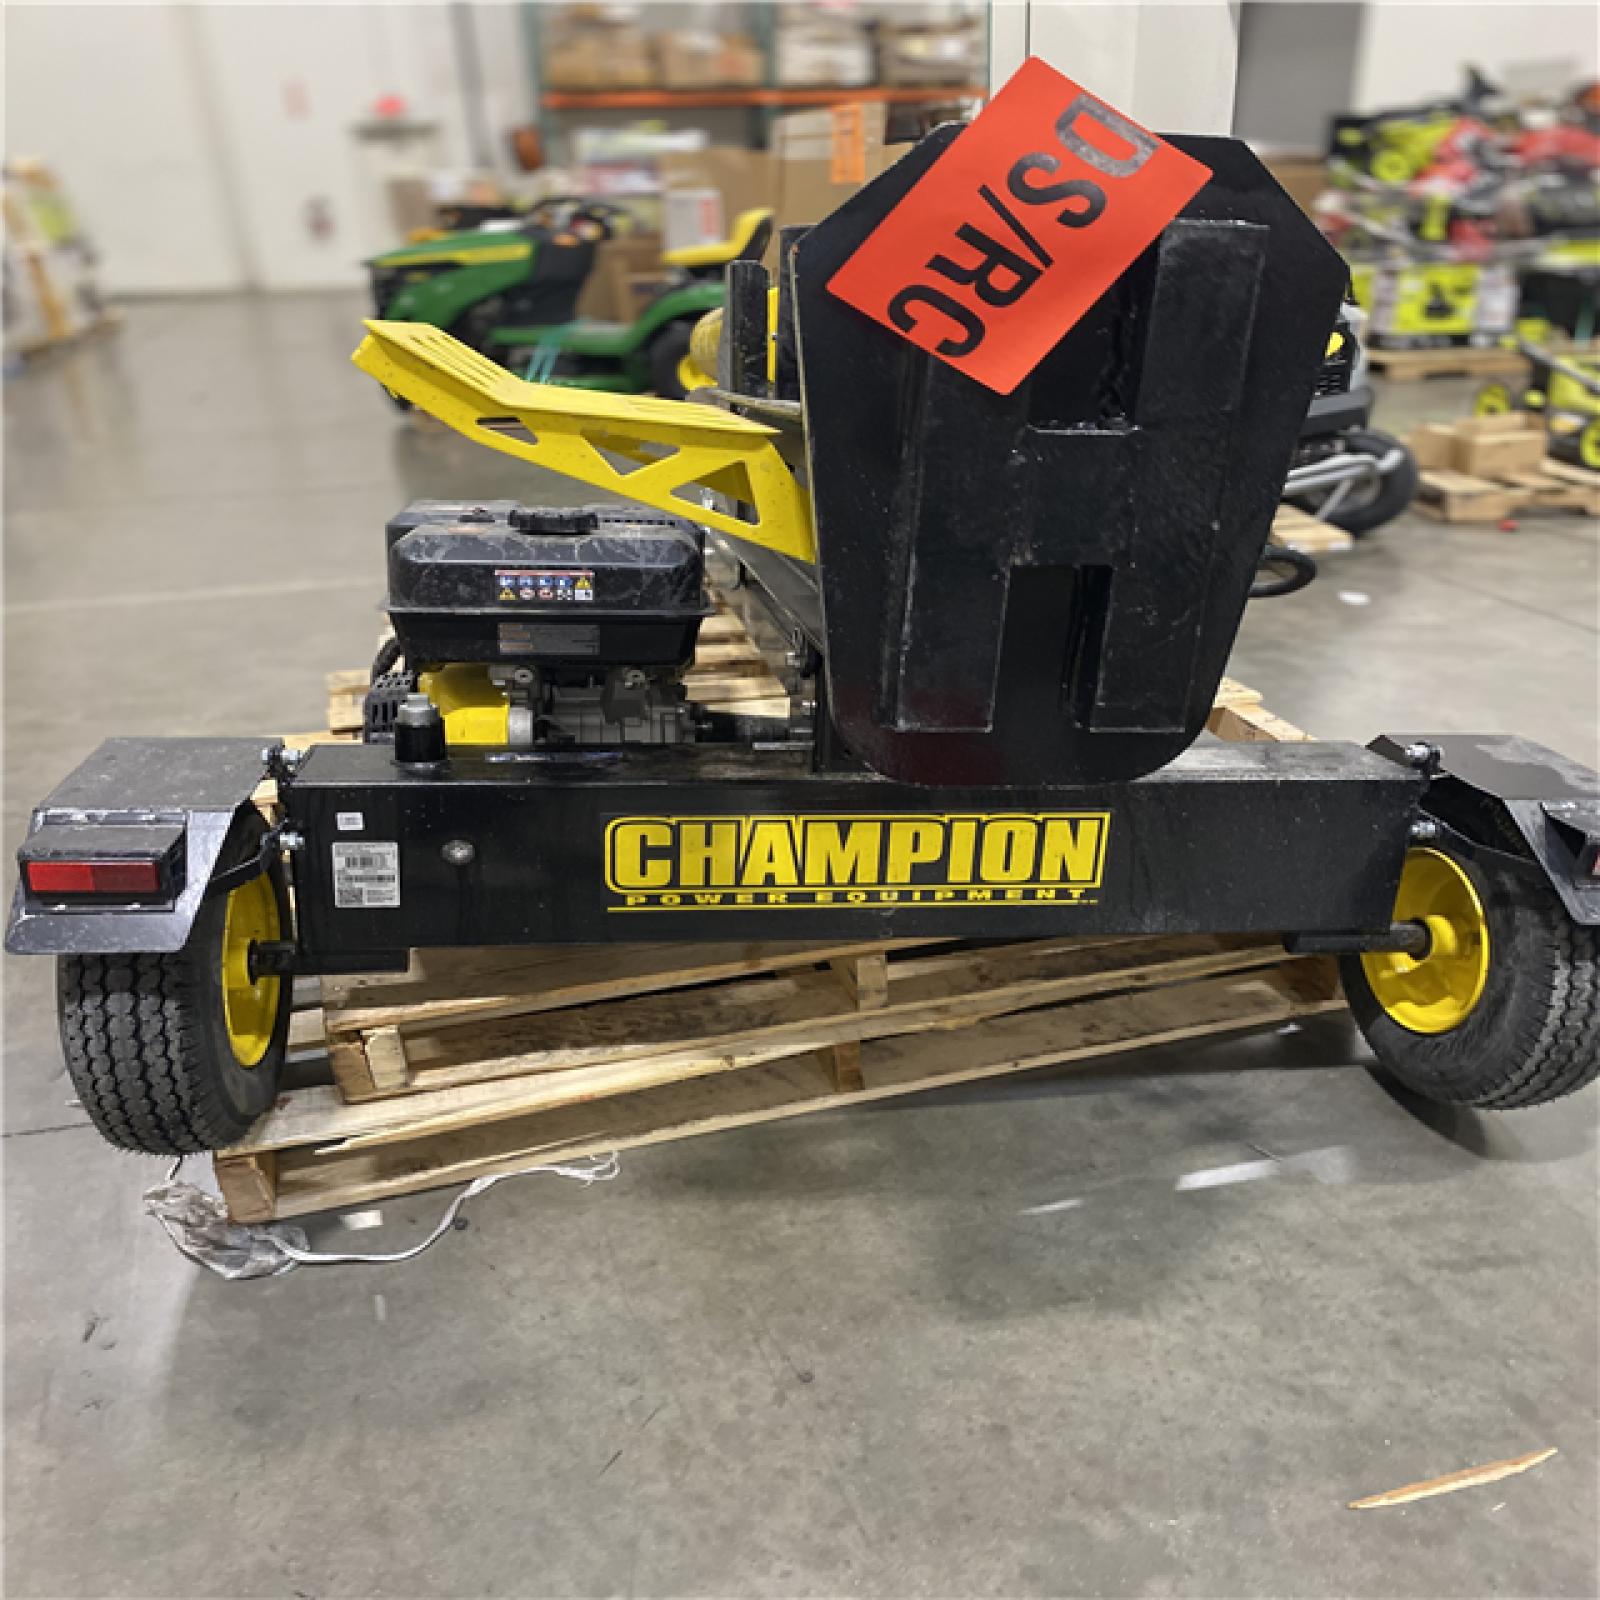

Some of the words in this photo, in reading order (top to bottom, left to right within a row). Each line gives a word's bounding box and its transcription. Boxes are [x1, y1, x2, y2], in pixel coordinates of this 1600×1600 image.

[887, 92, 1159, 358] DS/RC
[614, 819, 1100, 887] CHAMPION
[625, 893, 788, 906] POWER
[815, 889, 1086, 905] EQUIPMENT
